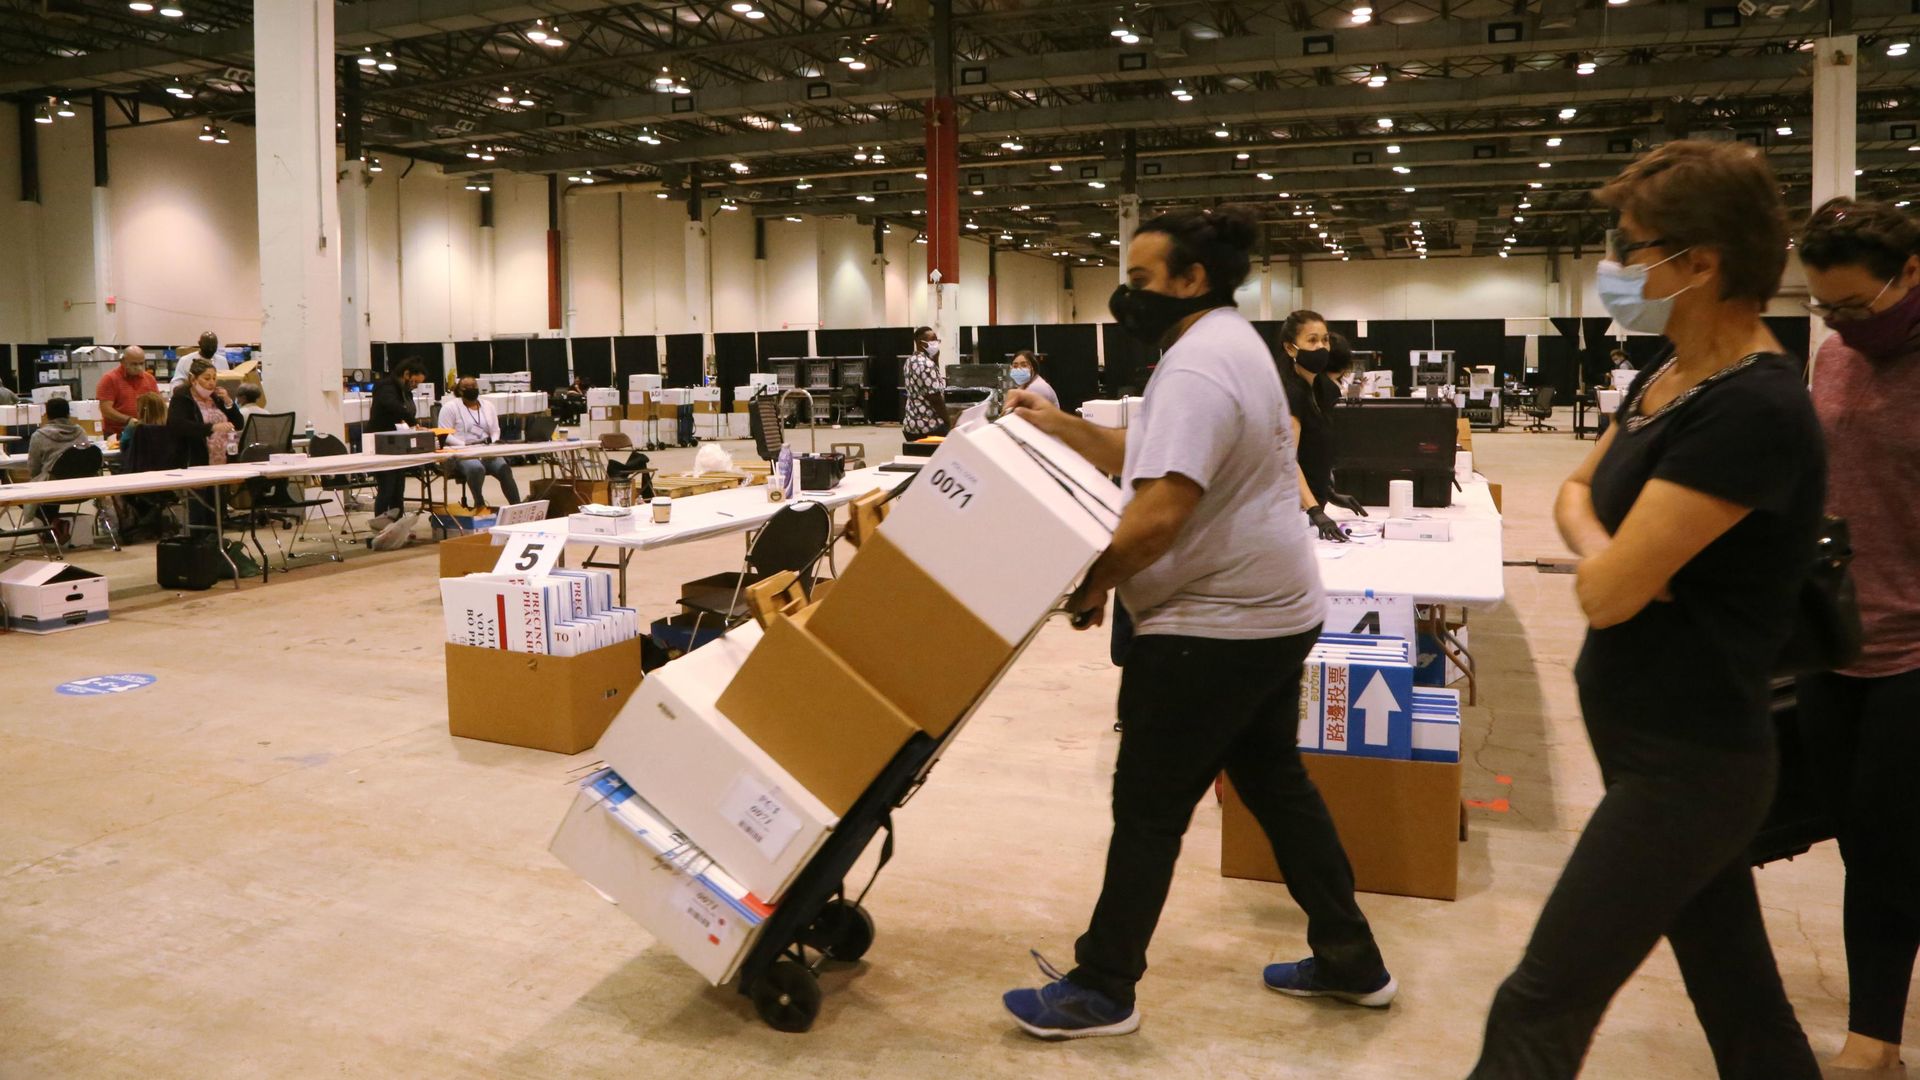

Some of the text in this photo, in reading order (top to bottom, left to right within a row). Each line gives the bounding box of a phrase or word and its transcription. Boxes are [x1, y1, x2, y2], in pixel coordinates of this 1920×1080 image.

[930, 469, 974, 509] 0071
[515, 544, 544, 571] 5
[554, 632, 569, 642] TO
[1326, 666, 1347, 742] 路邊投票
